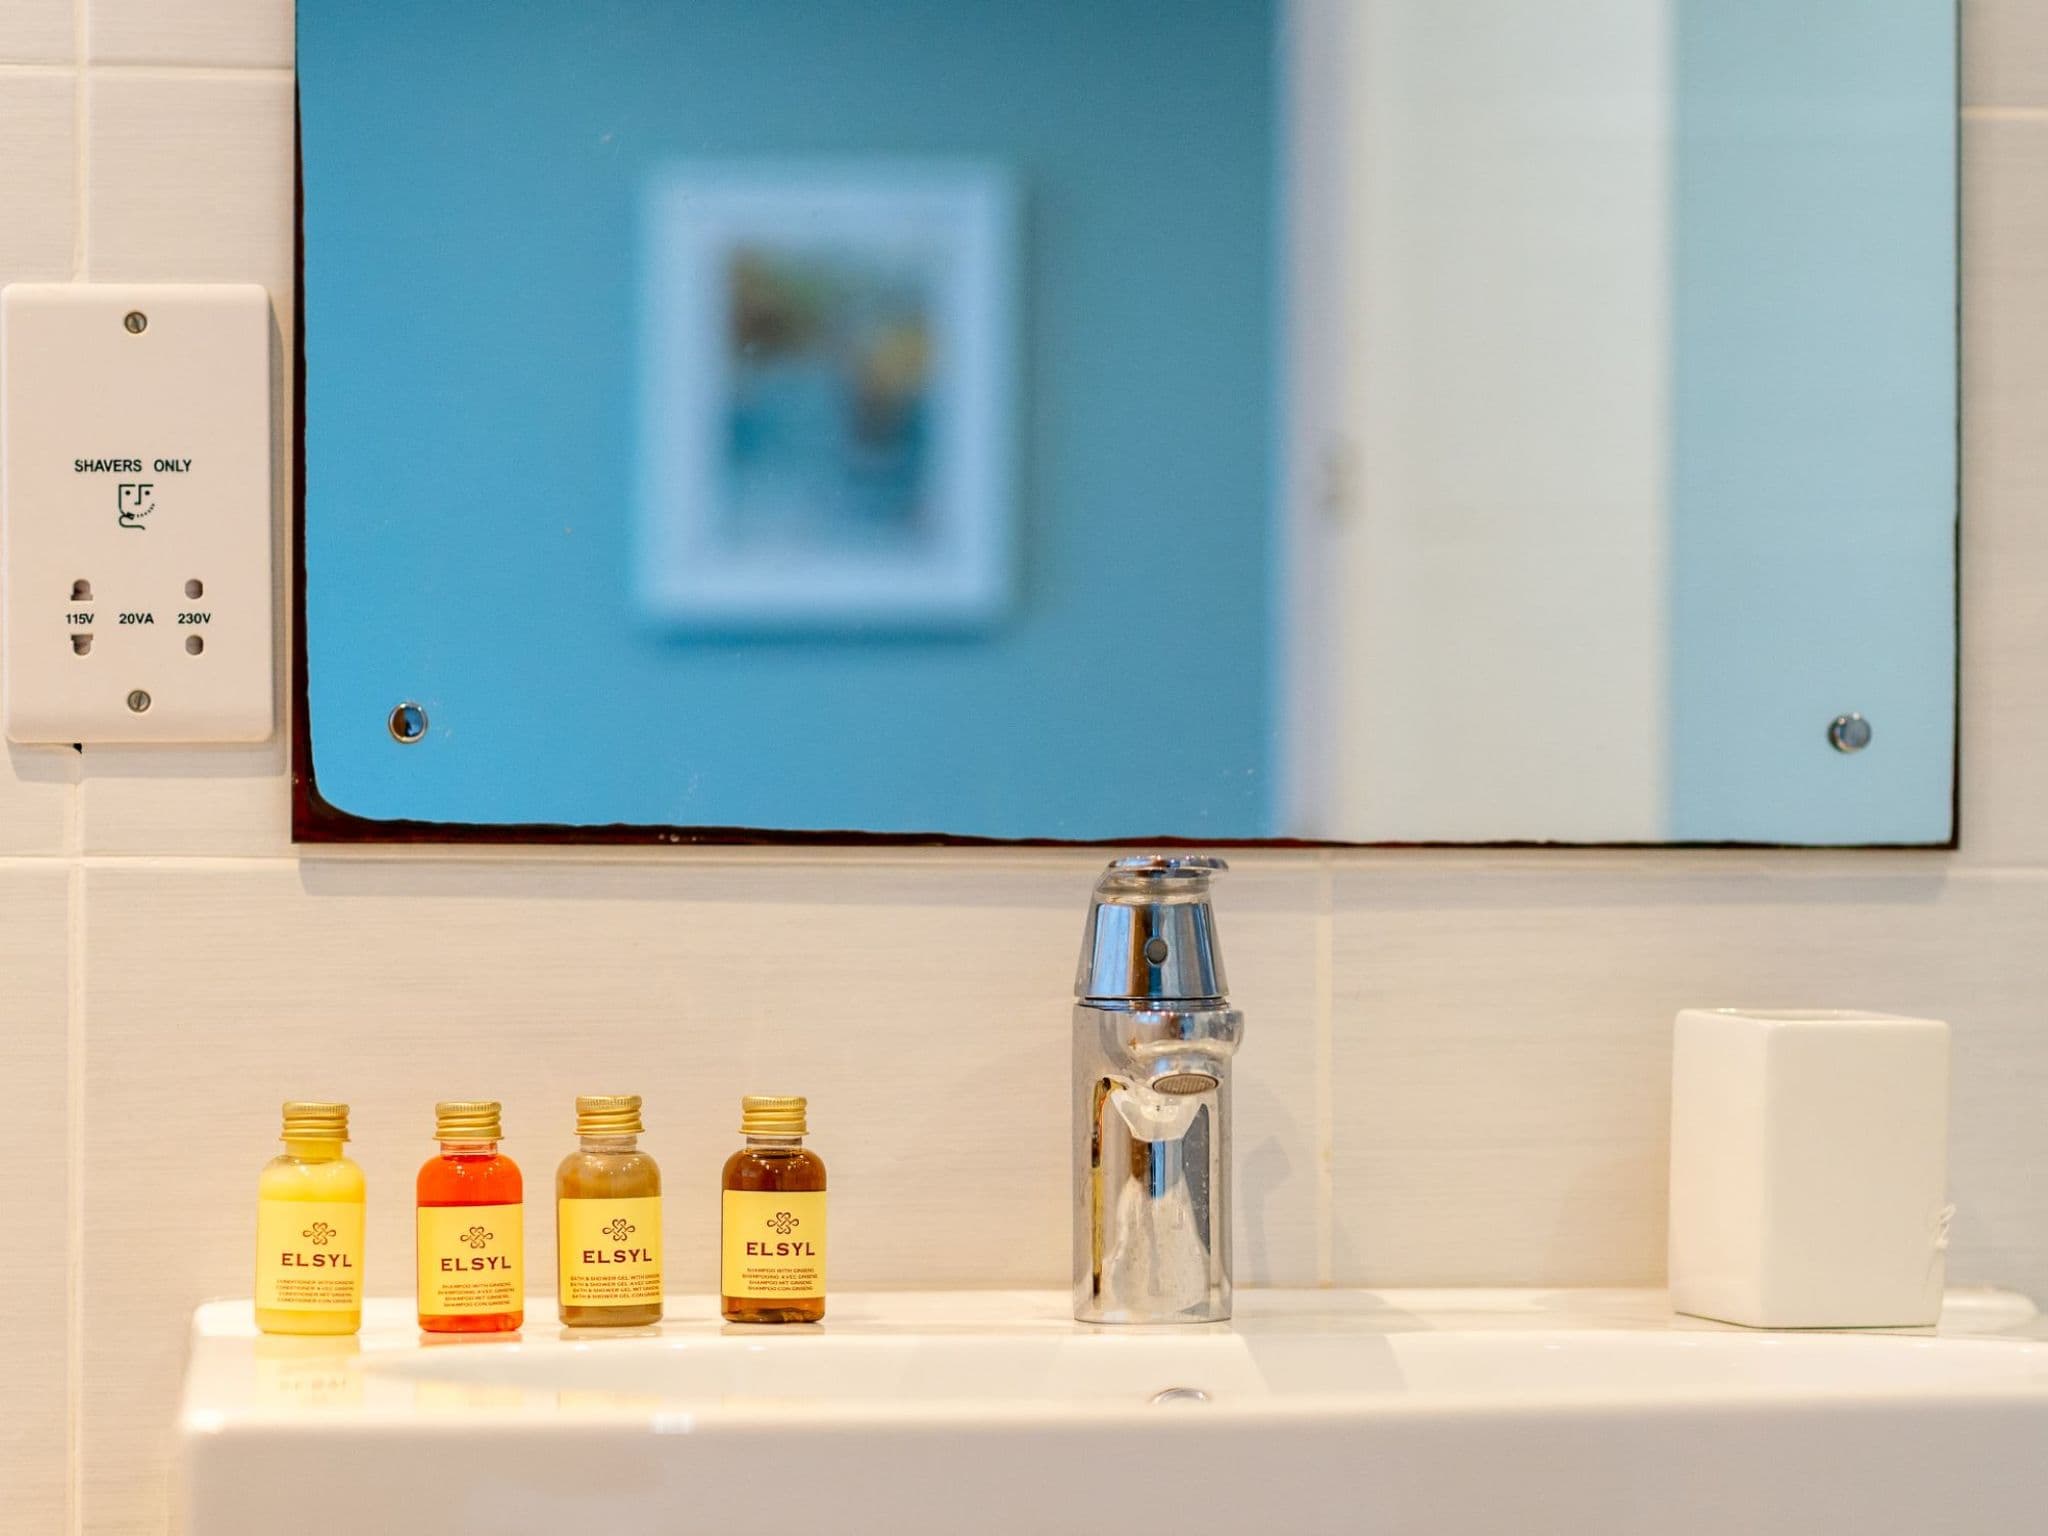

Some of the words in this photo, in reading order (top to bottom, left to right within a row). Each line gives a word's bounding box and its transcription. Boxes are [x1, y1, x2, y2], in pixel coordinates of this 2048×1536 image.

[74, 459, 142, 472] SHAVERS
[154, 459, 192, 472] ONLY
[66, 613, 95, 624] 115V
[119, 613, 154, 624] 20VA
[178, 613, 211, 624] 230V
[746, 1242, 815, 1256] ELSYL
[282, 1253, 352, 1267] ELSYL
[583, 1248, 652, 1264] ELSYL
[441, 1256, 511, 1271] ELSYL
